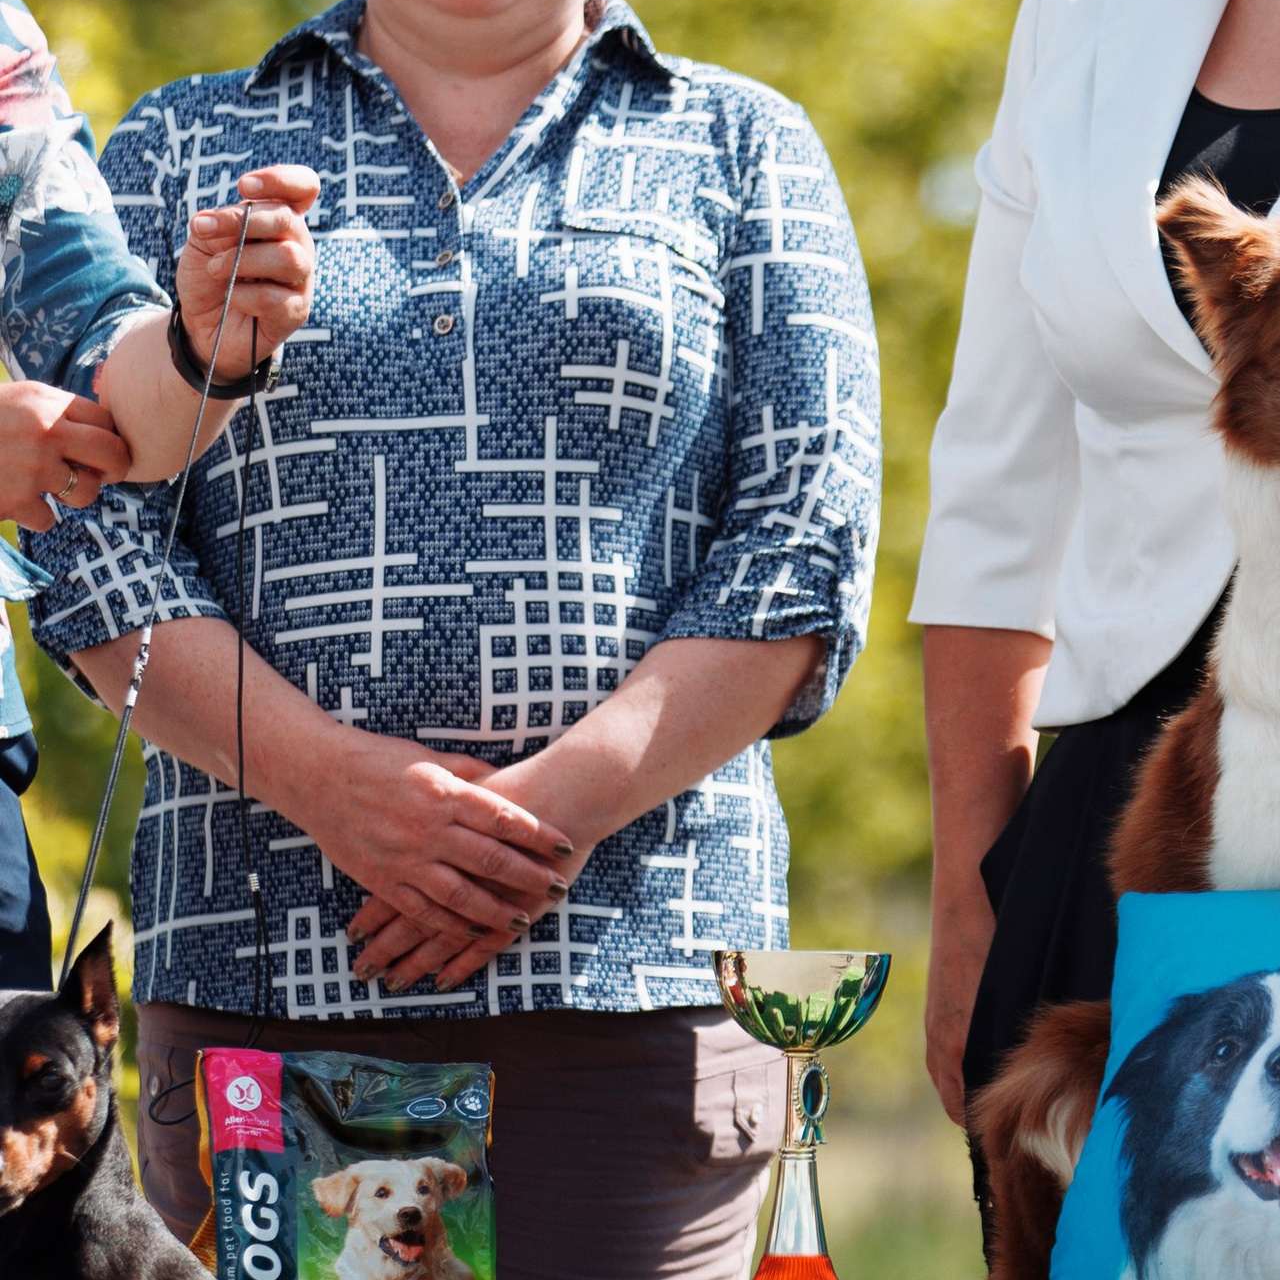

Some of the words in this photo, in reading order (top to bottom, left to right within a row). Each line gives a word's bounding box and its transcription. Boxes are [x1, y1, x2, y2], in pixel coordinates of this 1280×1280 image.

[220, 1171, 230, 1192] for
[221, 1198, 233, 1227] food
[226, 1232, 235, 1260] pet
